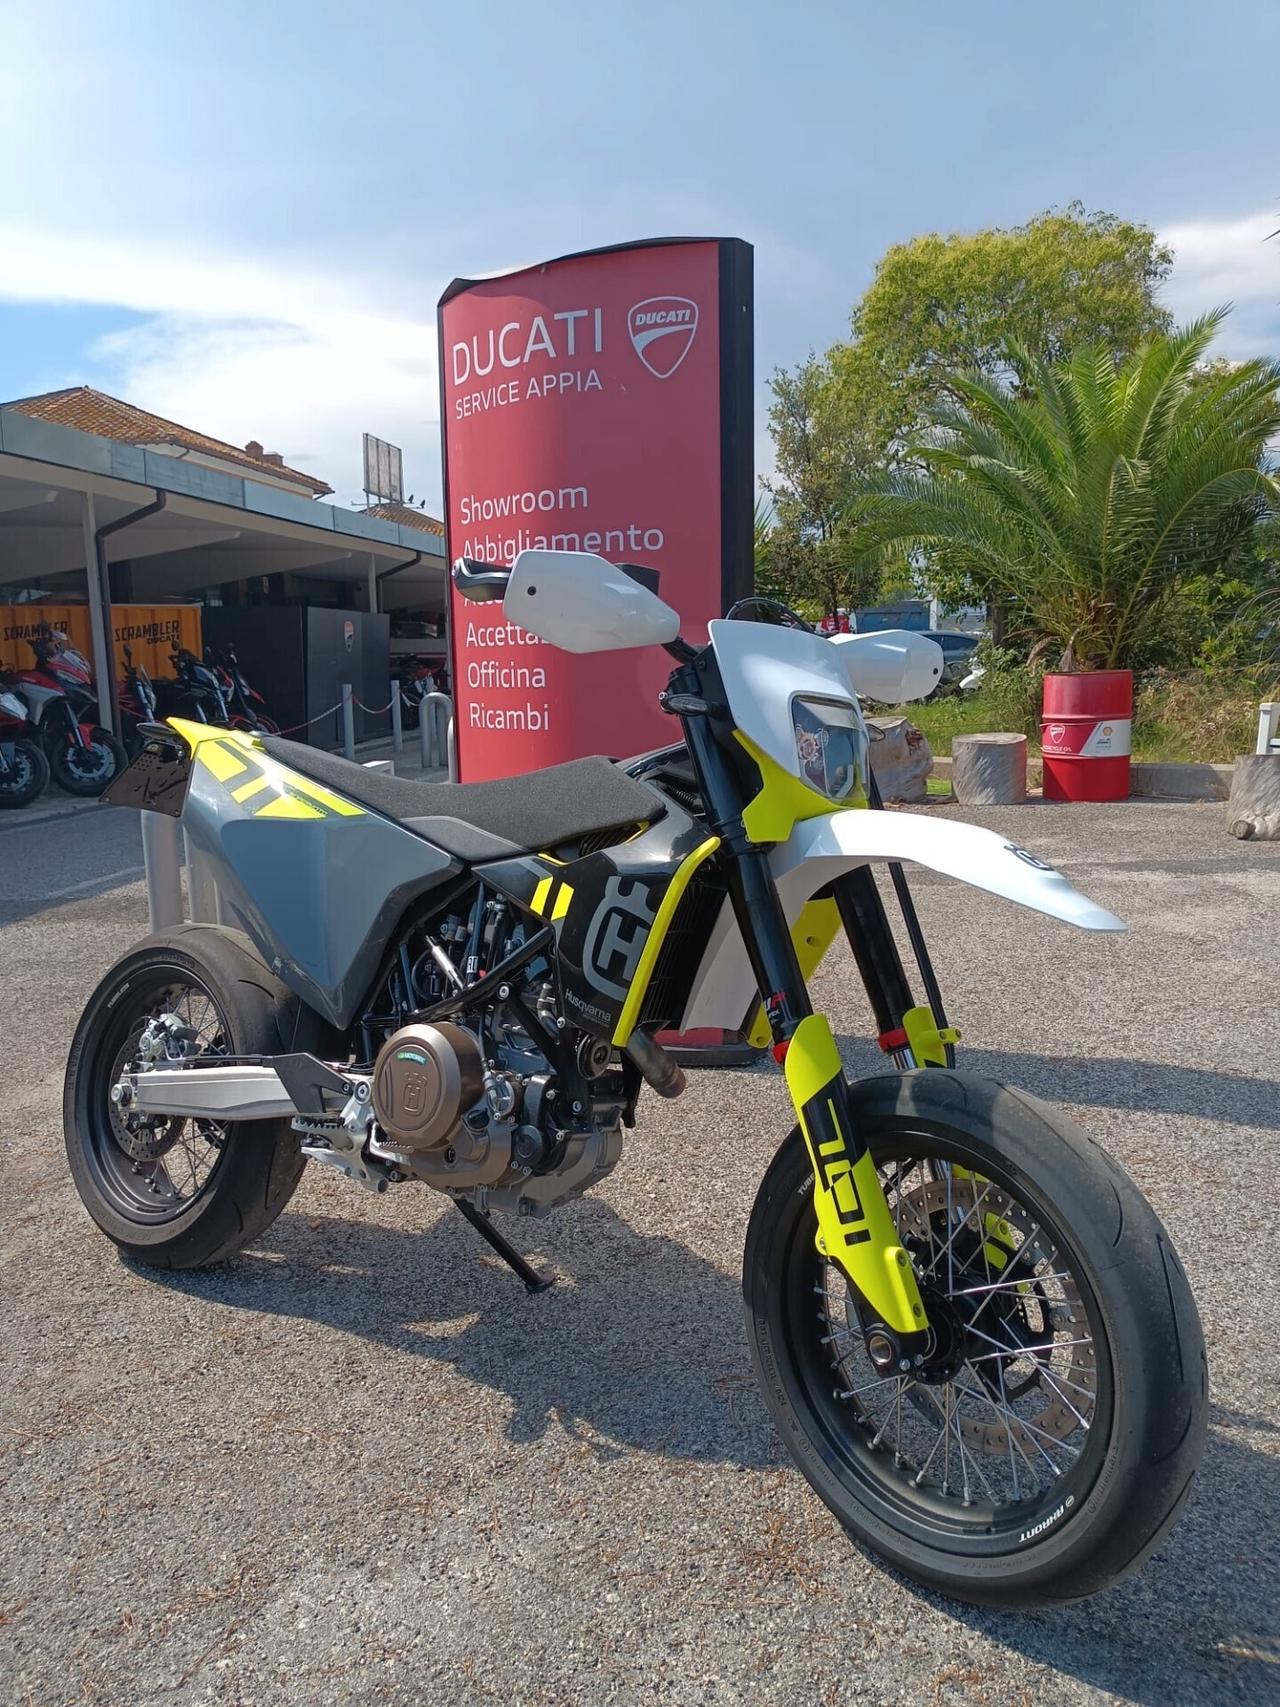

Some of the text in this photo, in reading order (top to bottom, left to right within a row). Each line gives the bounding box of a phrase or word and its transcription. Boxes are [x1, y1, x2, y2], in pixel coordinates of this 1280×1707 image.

[635, 309, 691, 326] DUCATI
[452, 308, 602, 385] DUCATI
[456, 369, 603, 420] SERVICE APPIA
[460, 486, 588, 524] Showroom
[463, 524, 664, 567] Abbigliamento
[115, 620, 179, 642] SCRAMBLER
[466, 621, 547, 648] Accetta
[467, 661, 546, 689] Officina
[470, 703, 549, 730] Ricambi
[565, 987, 611, 1022] Husqvarna
